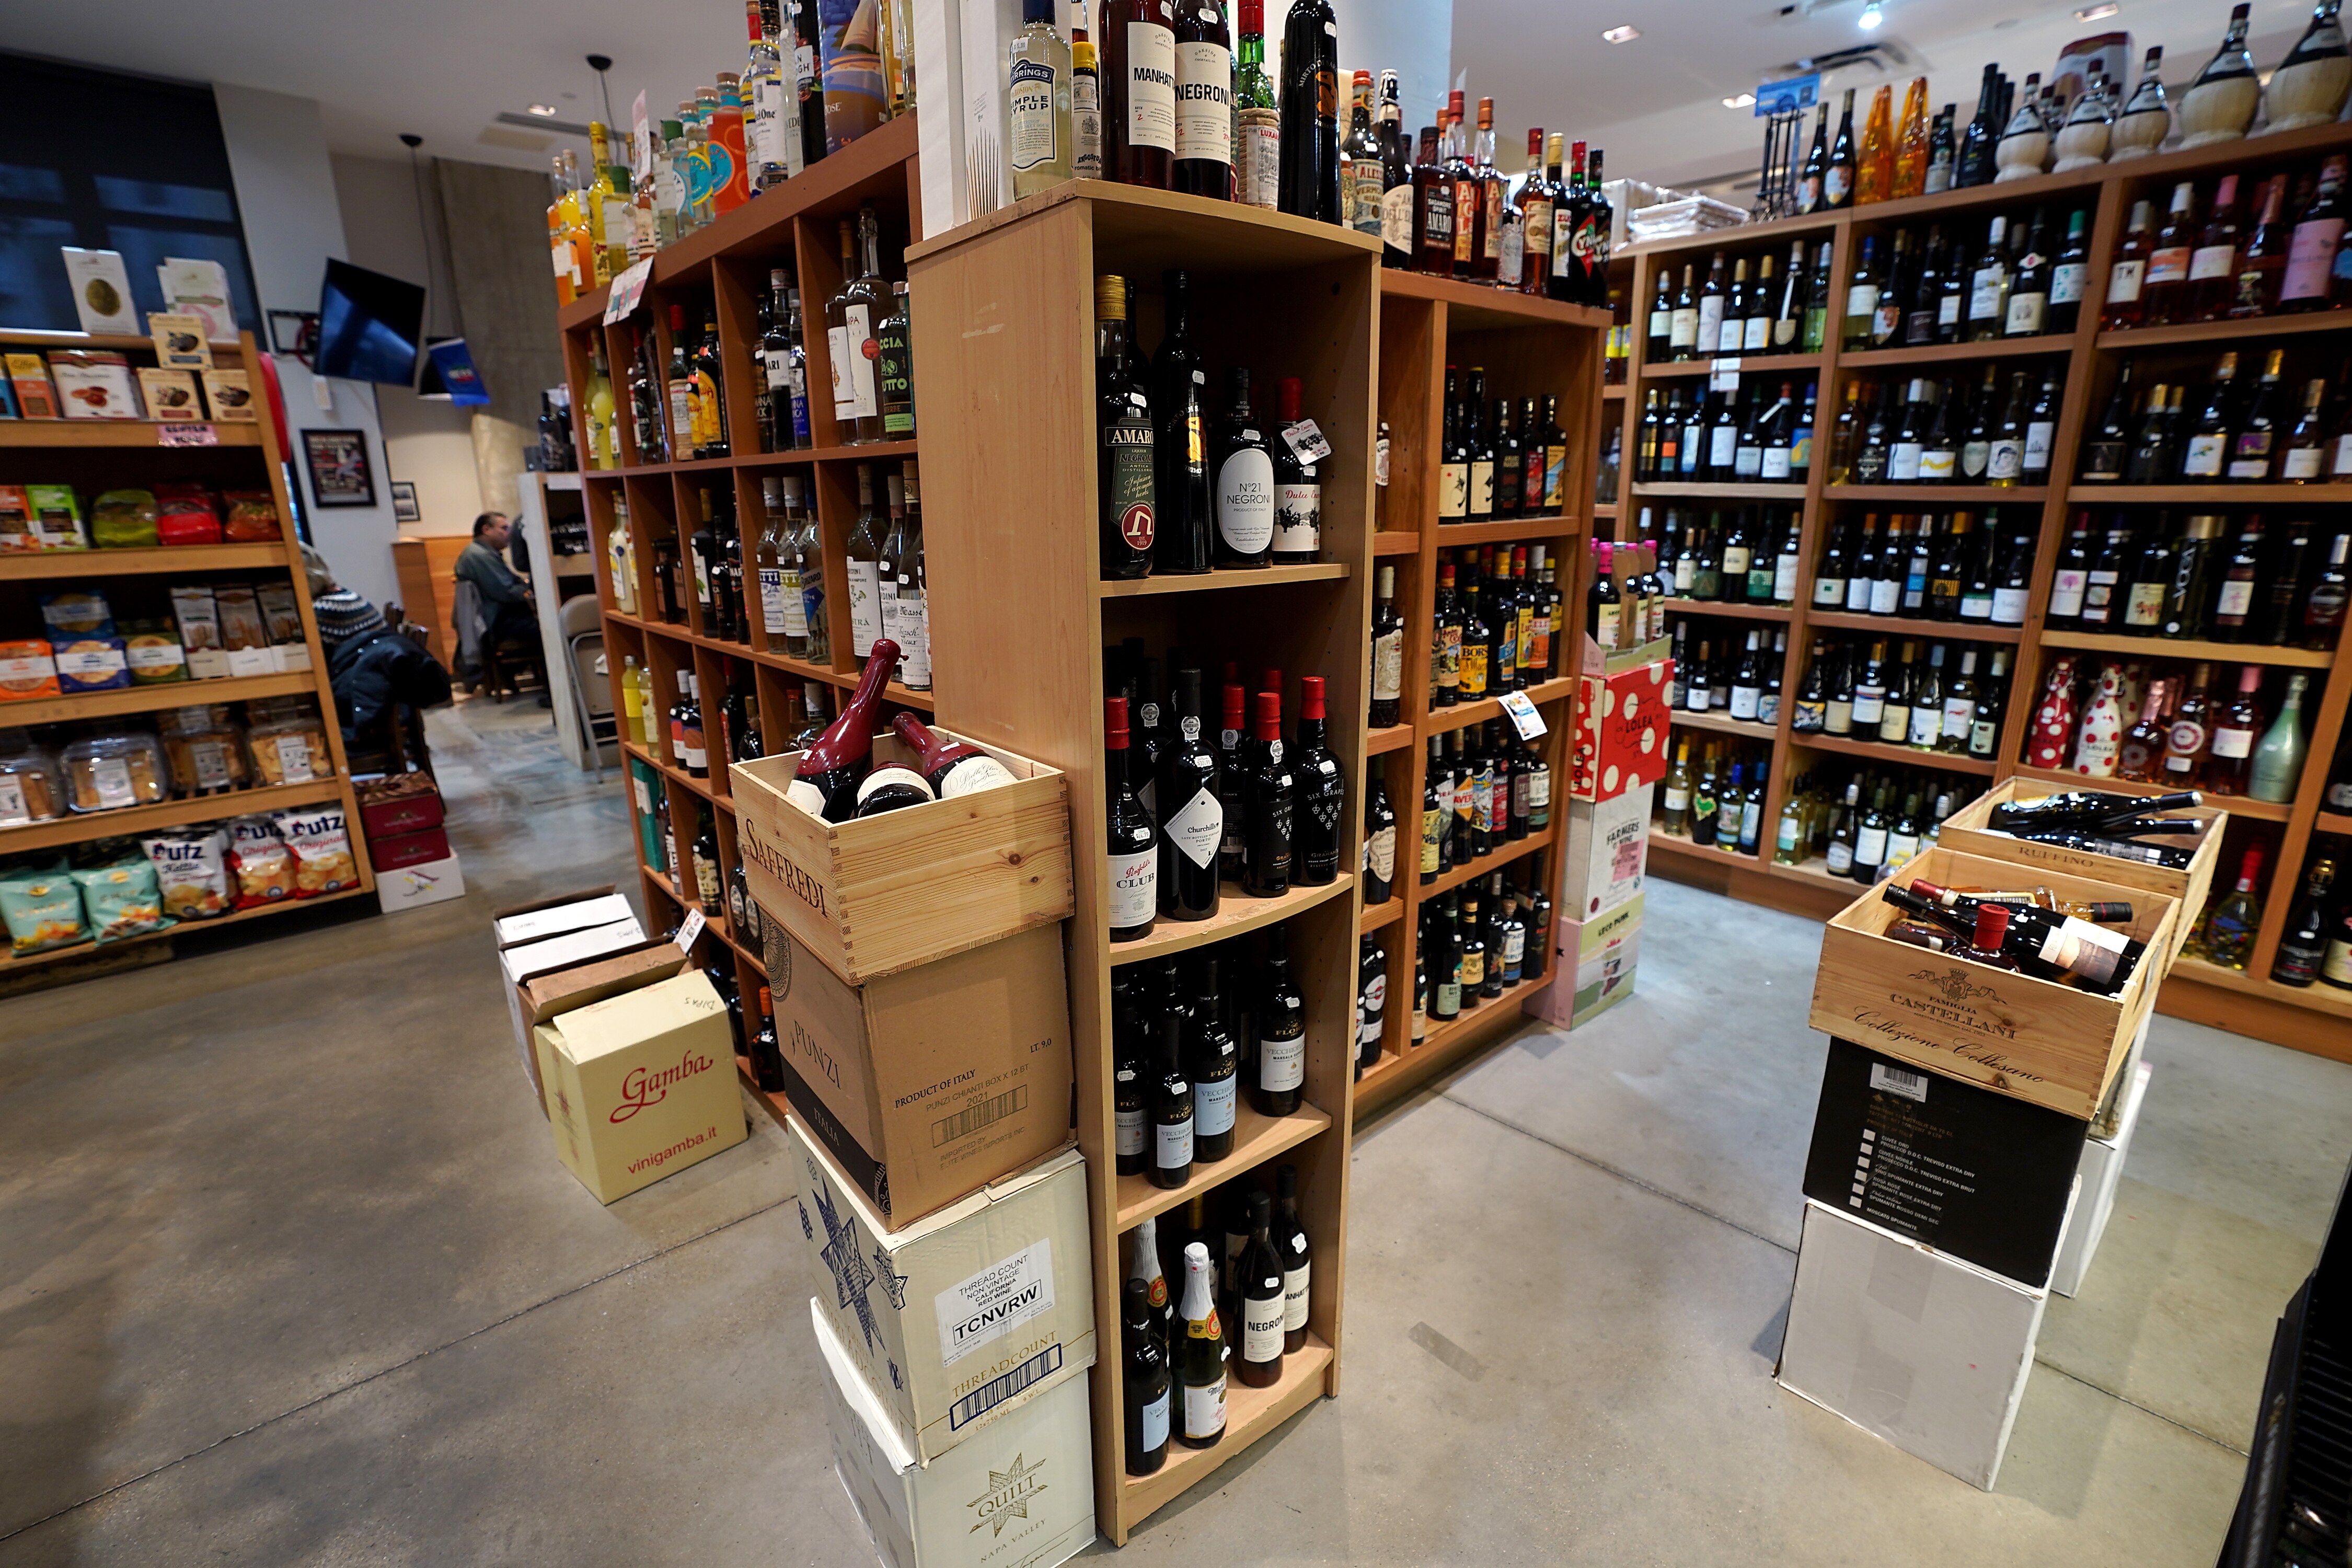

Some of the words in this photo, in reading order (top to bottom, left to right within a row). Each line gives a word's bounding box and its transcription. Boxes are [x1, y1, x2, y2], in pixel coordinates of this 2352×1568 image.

[1134, 67, 1175, 91] MANHATT
[1298, 62, 1316, 87] MIRTO
[1260, 129, 1279, 141] LUXAR
[1077, 152, 1101, 164] ANGOSTU
[1360, 165, 1384, 179] ALESS
[1357, 185, 1384, 194] VERMO
[880, 337, 904, 350] CCIA
[882, 377, 908, 392] UTTO
[1111, 430, 1154, 444] AMARO
[1226, 494, 1271, 505] NEGRONI
[900, 606, 923, 616] Masse
[1463, 647, 1488, 658] BORS
[1626, 716, 1653, 733] LOLEA
[1307, 792, 1321, 801] SIX
[1454, 795, 1473, 804] AVER
[1273, 809, 1283, 817] SIX
[310, 815, 344, 836] utz
[168, 843, 205, 861] utz
[2019, 847, 2094, 868] RUFFINO
[745, 818, 828, 919] SAFFREDI
[1116, 872, 1154, 889] CLUB
[1889, 993, 2016, 1040] CASTELLANI
[1929, 996, 1977, 1015] FAMIGLIA
[793, 1019, 841, 1091] PUNZI
[1030, 1043, 1041, 1054] LT.
[1854, 1005, 1941, 1051] Collezione
[1952, 1037, 2044, 1083] Collesano
[609, 1049, 714, 1124] Gamba
[895, 1084, 938, 1109] PRODUCT
[939, 1078, 952, 1090] OF
[953, 1069, 976, 1085] ITALY
[926, 1096, 951, 1112] PUNZI
[952, 1083, 984, 1101] CHIANTI
[985, 1076, 1002, 1088] BOX
[1002, 1071, 1009, 1080] X
[1010, 1068, 1019, 1077] 12
[966, 1091, 988, 1107] 2021
[814, 1108, 840, 1147] ITALIA
[628, 1126, 717, 1174] vinigamba.it
[940, 1139, 977, 1162] IMPORTED
[978, 1135, 987, 1144] BY
[940, 1155, 960, 1170] ELITE
[960, 1146, 983, 1160] WINES
[1880, 1141, 1907, 1155] PROSECCO
[1923, 1155, 1945, 1169] TREVISO
[1945, 1163, 1963, 1175] EXTRA
[1964, 1170, 1976, 1179] DRY
[1877, 1154, 1904, 1169] PROSECCO
[1920, 1169, 1942, 1182] TREVISO
[1942, 1177, 1961, 1189] EXTRA
[1961, 1184, 1976, 1194] BRUT
[1887, 1172, 1915, 1187] SPUMANTE
[1915, 1181, 1932, 1193] EXTRA
[1932, 1189, 1944, 1197] DRY
[1872, 1181, 1899, 1196] SPUMANTE
[1913, 1196, 1930, 1208] EXTRA
[1930, 1202, 1943, 1212] DRY
[1866, 1207, 1890, 1220] MOSCATO
[1890, 1216, 1918, 1231] SPUMANTE
[1869, 1195, 1896, 1209] SPUMANTE
[1896, 1204, 1914, 1216] ROSSO
[1914, 1210, 1928, 1222] DEMI
[1928, 1217, 1940, 1226] SEC
[959, 1272, 996, 1296] THREAD
[998, 1254, 1029, 1276] COUNT
[967, 1287, 984, 1300] NON
[986, 1268, 1020, 1289] VINTAGE
[975, 1278, 1017, 1302] CALIFORNIA
[978, 1297, 993, 1308] RED
[994, 1286, 1012, 1299] WINE
[1285, 1284, 1310, 1301] ANHATT
[955, 1285, 1037, 1339] TCNVRW
[952, 1330, 1057, 1398] THREADCOUNT
[978, 1473, 1036, 1517] QUILT
[981, 1543, 1007, 1564] NAPA
[1011, 1518, 1046, 1543] VALLEY
